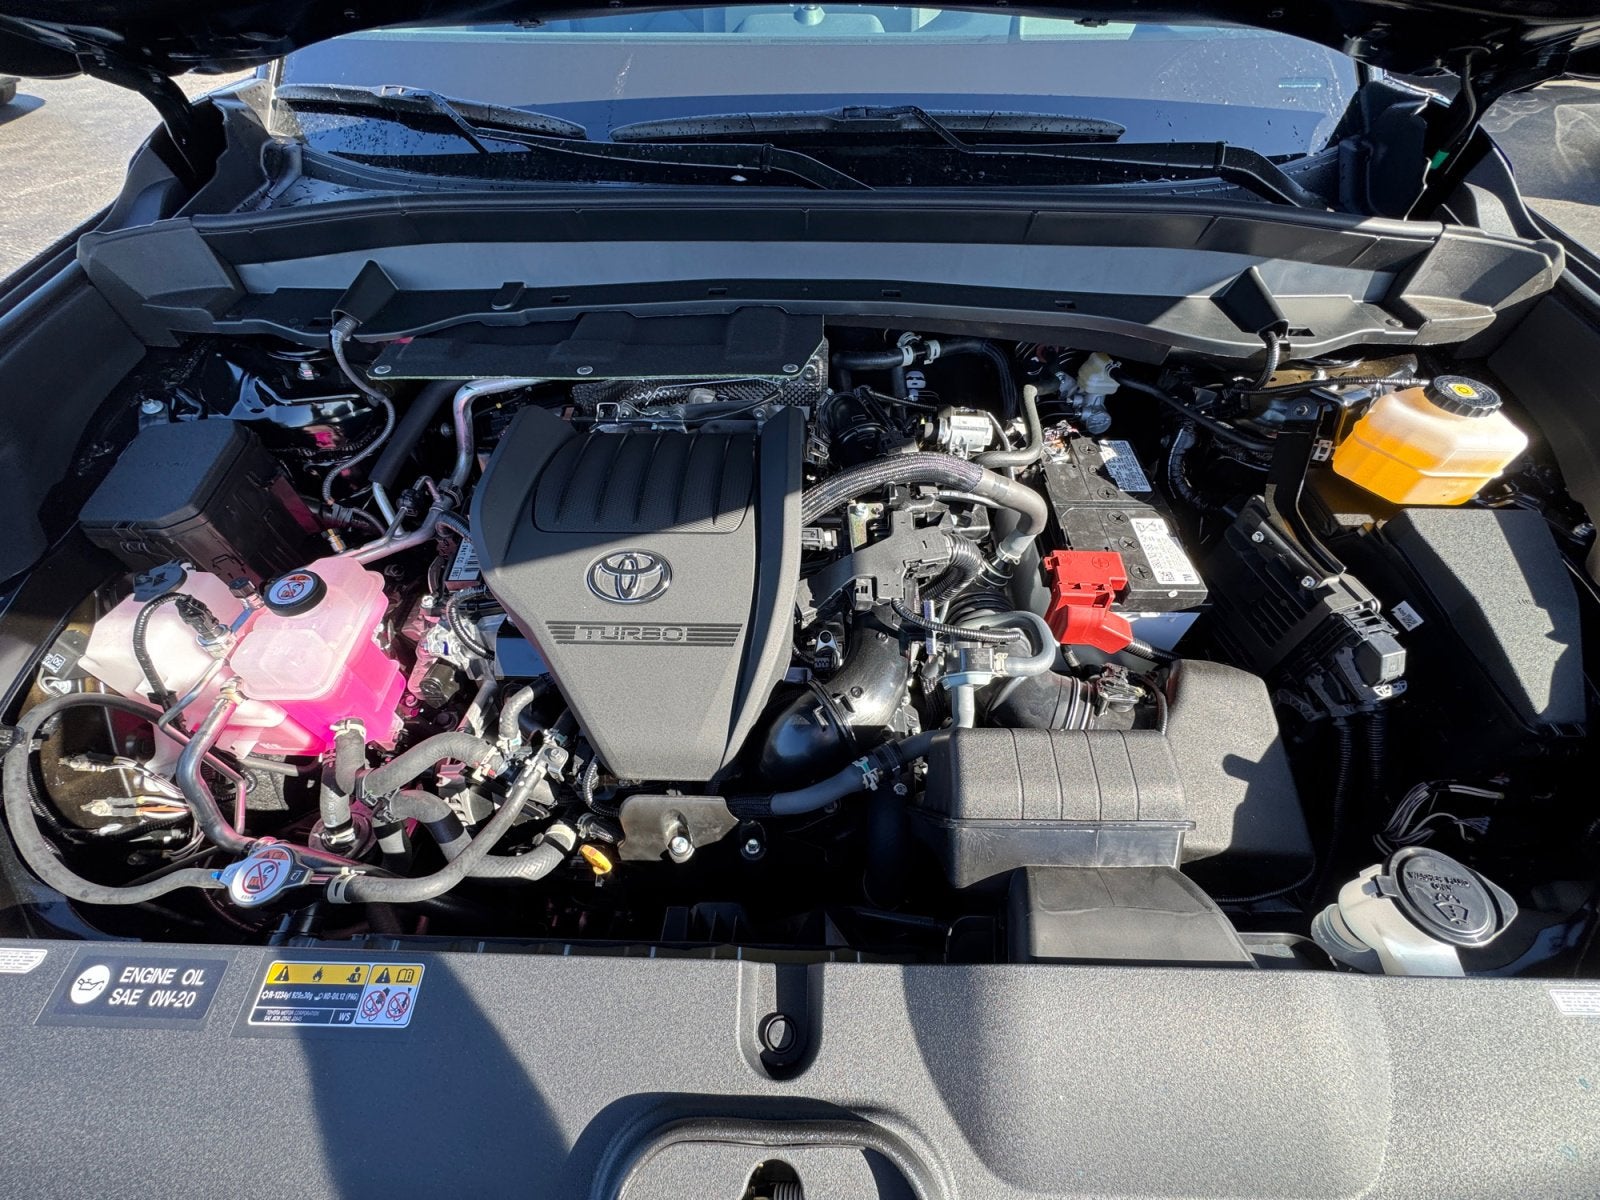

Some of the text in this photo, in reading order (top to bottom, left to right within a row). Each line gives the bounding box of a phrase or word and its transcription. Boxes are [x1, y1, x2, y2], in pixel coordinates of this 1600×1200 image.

[579, 626, 684, 641] TURBO
[119, 966, 205, 986] ENGINE OIL
[108, 988, 197, 1008] SAE 0W-20
[338, 1012, 352, 1022] WS
